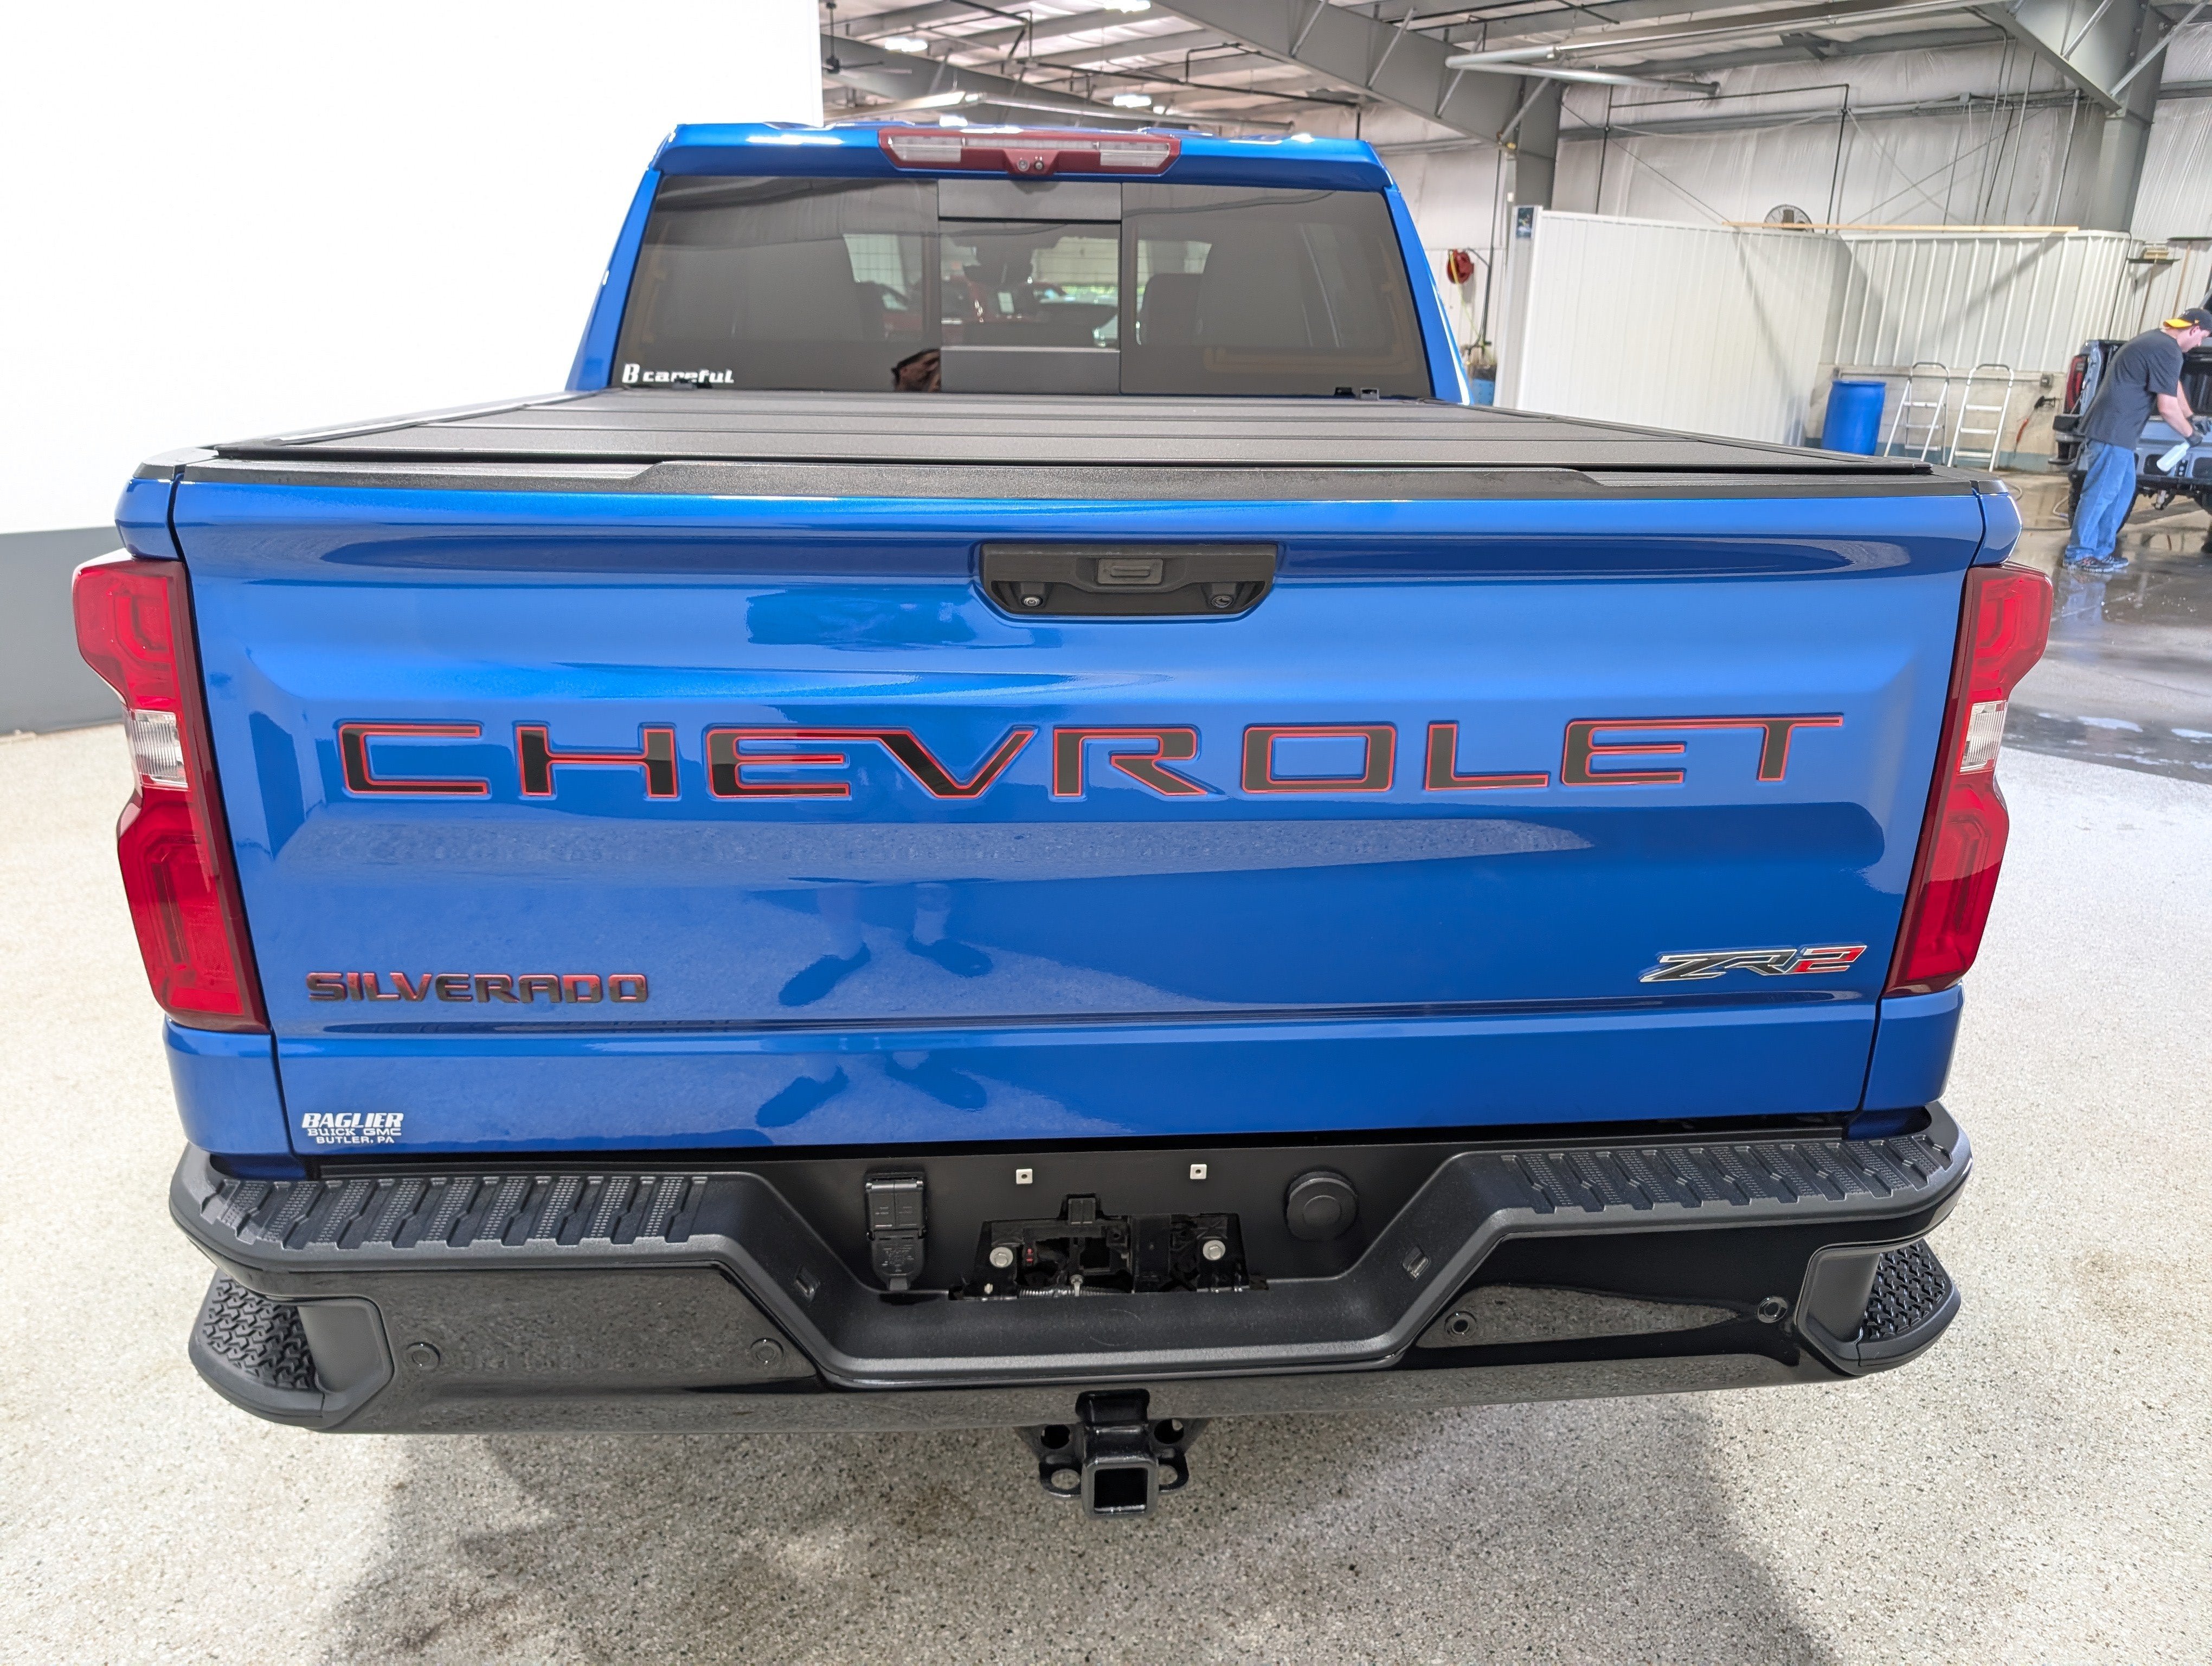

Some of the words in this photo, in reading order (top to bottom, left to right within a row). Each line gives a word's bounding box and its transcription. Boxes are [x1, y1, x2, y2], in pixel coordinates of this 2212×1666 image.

[622, 363, 640, 383] B
[642, 369, 734, 383] careful
[338, 716, 1843, 800] CHEVROLET
[1639, 944, 1867, 982] ZR2
[306, 972, 649, 1003] SILVERADO
[301, 1112, 404, 1128] BAGLIER
[307, 1128, 356, 1136] BUICK
[363, 1128, 402, 1136] GMC
[316, 1136, 374, 1144] BUTLER,
